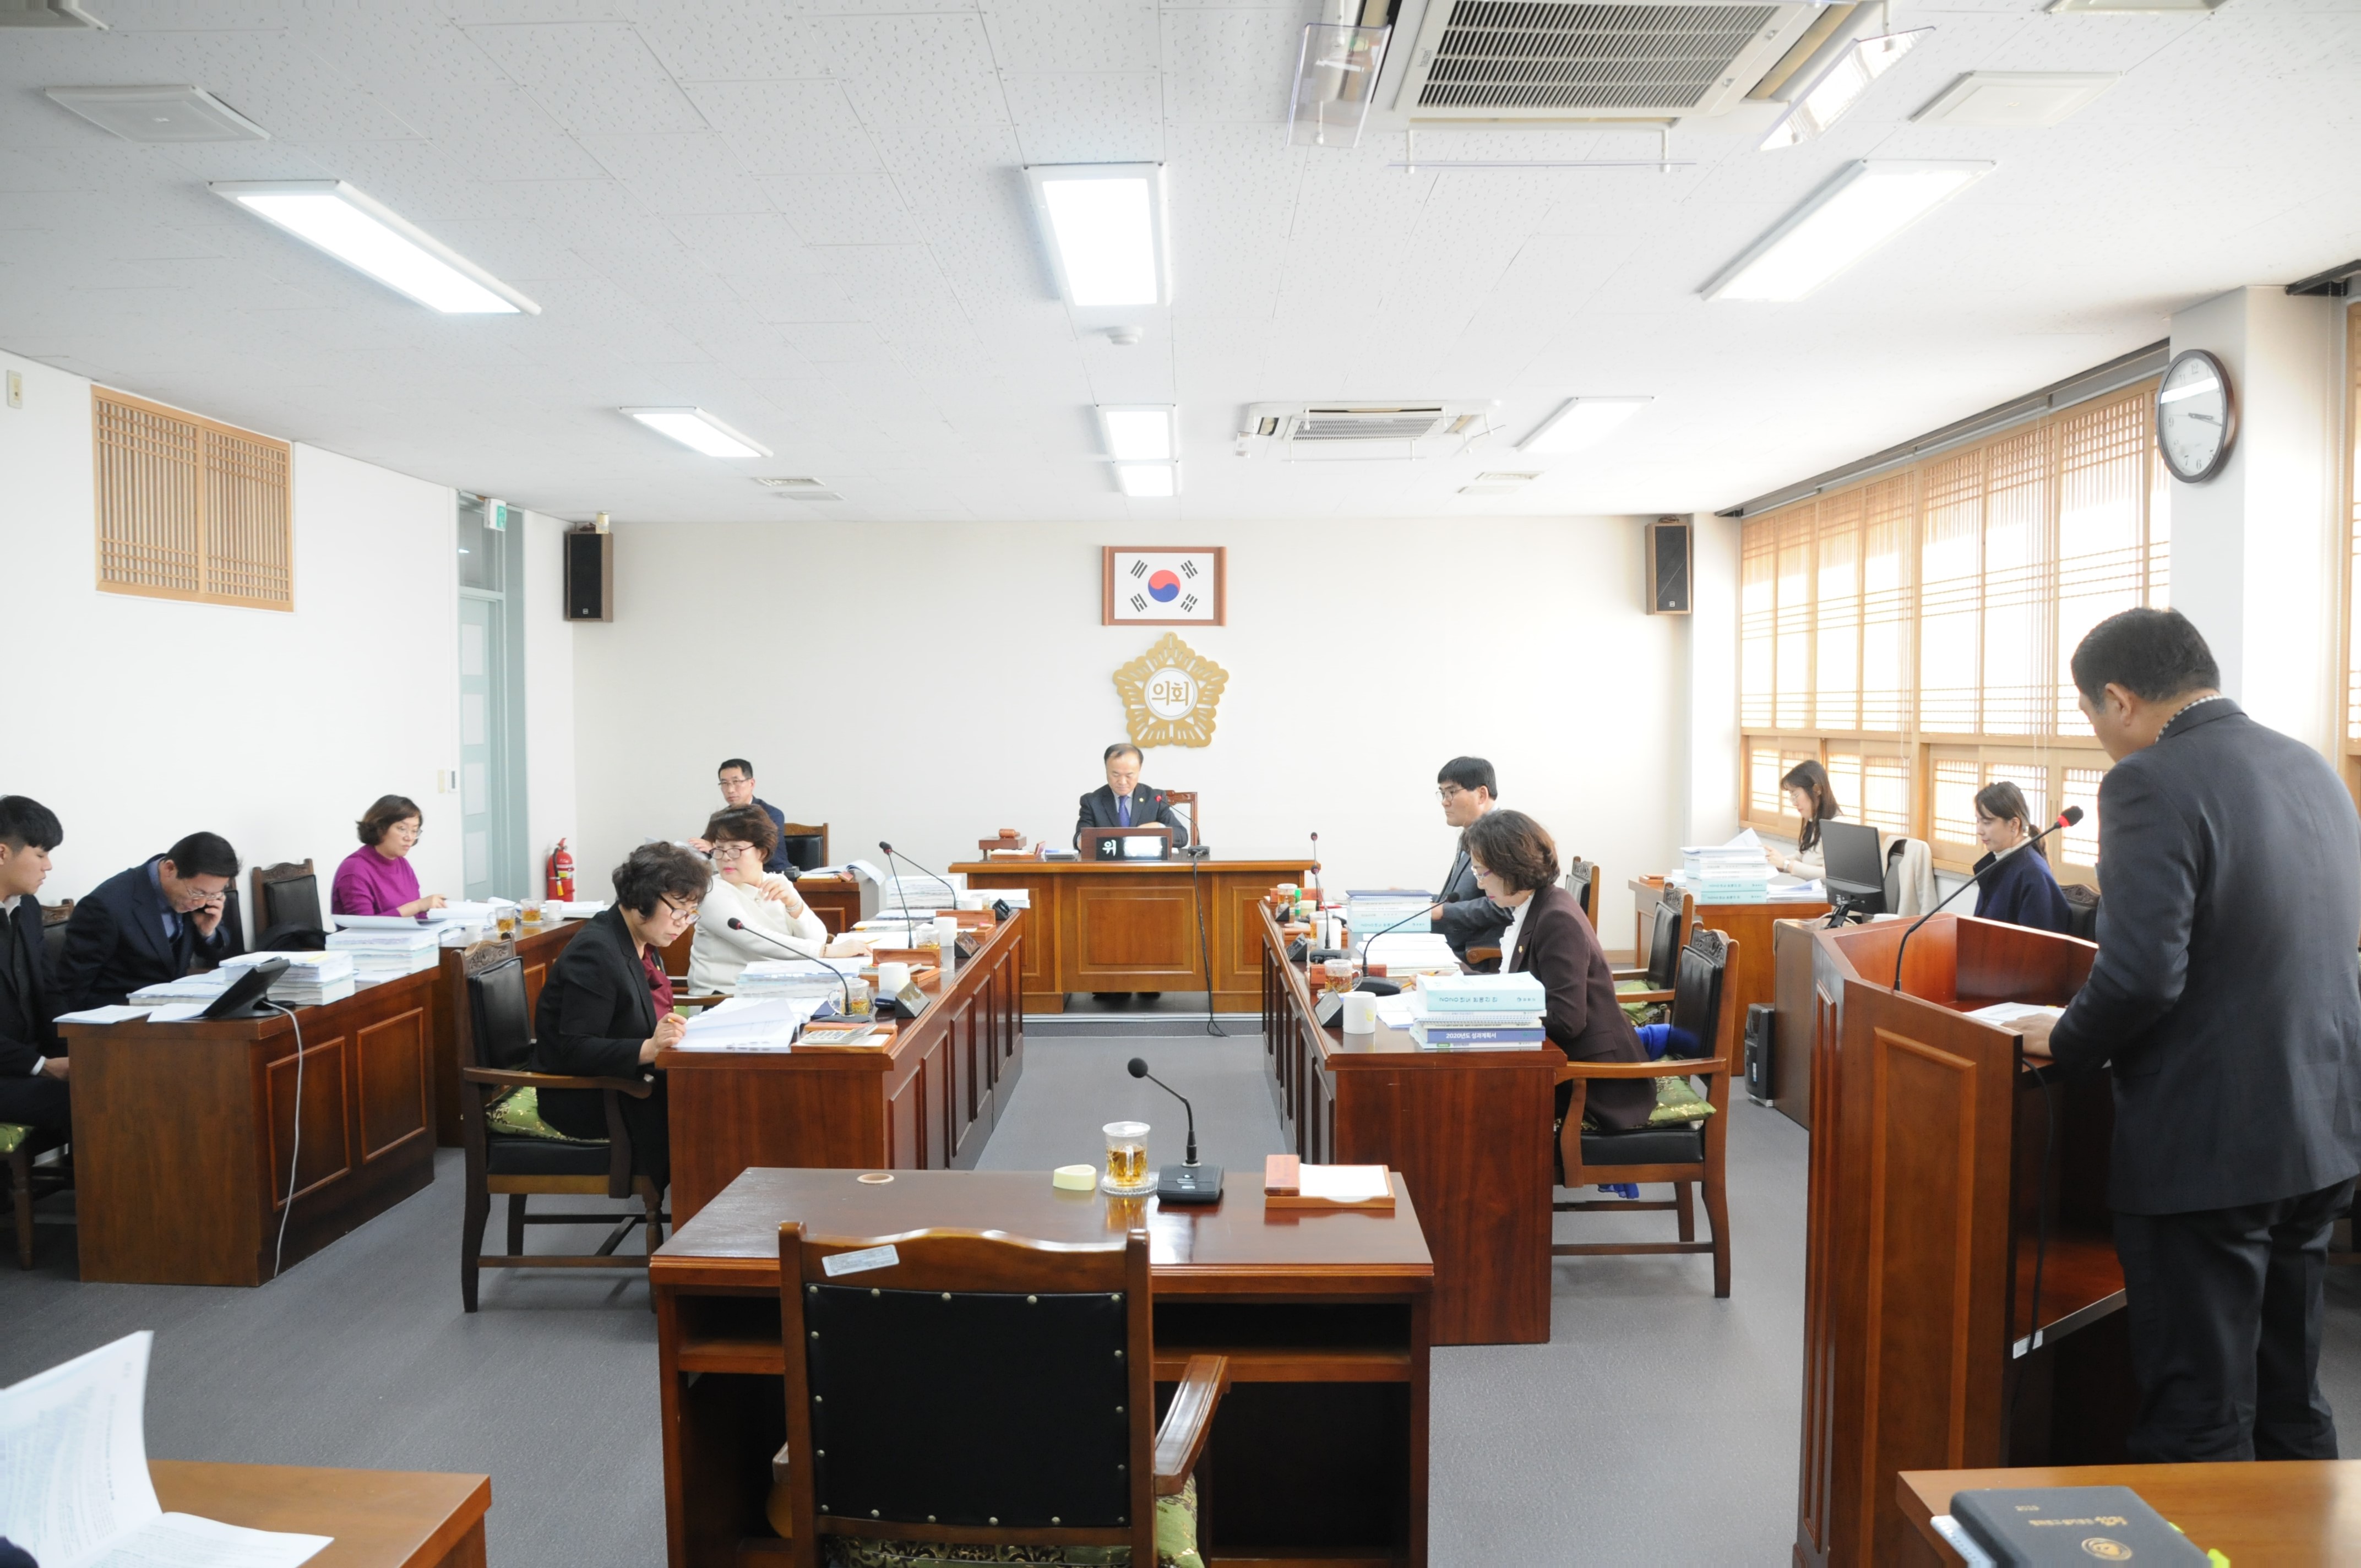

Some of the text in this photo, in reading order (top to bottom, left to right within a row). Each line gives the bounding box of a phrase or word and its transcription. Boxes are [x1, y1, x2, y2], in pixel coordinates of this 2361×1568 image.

[2169, 417, 2174, 428] 9
[2184, 455, 2189, 466] 7
[2196, 459, 2202, 470] 6
[1151, 680, 1189, 706] 의회
